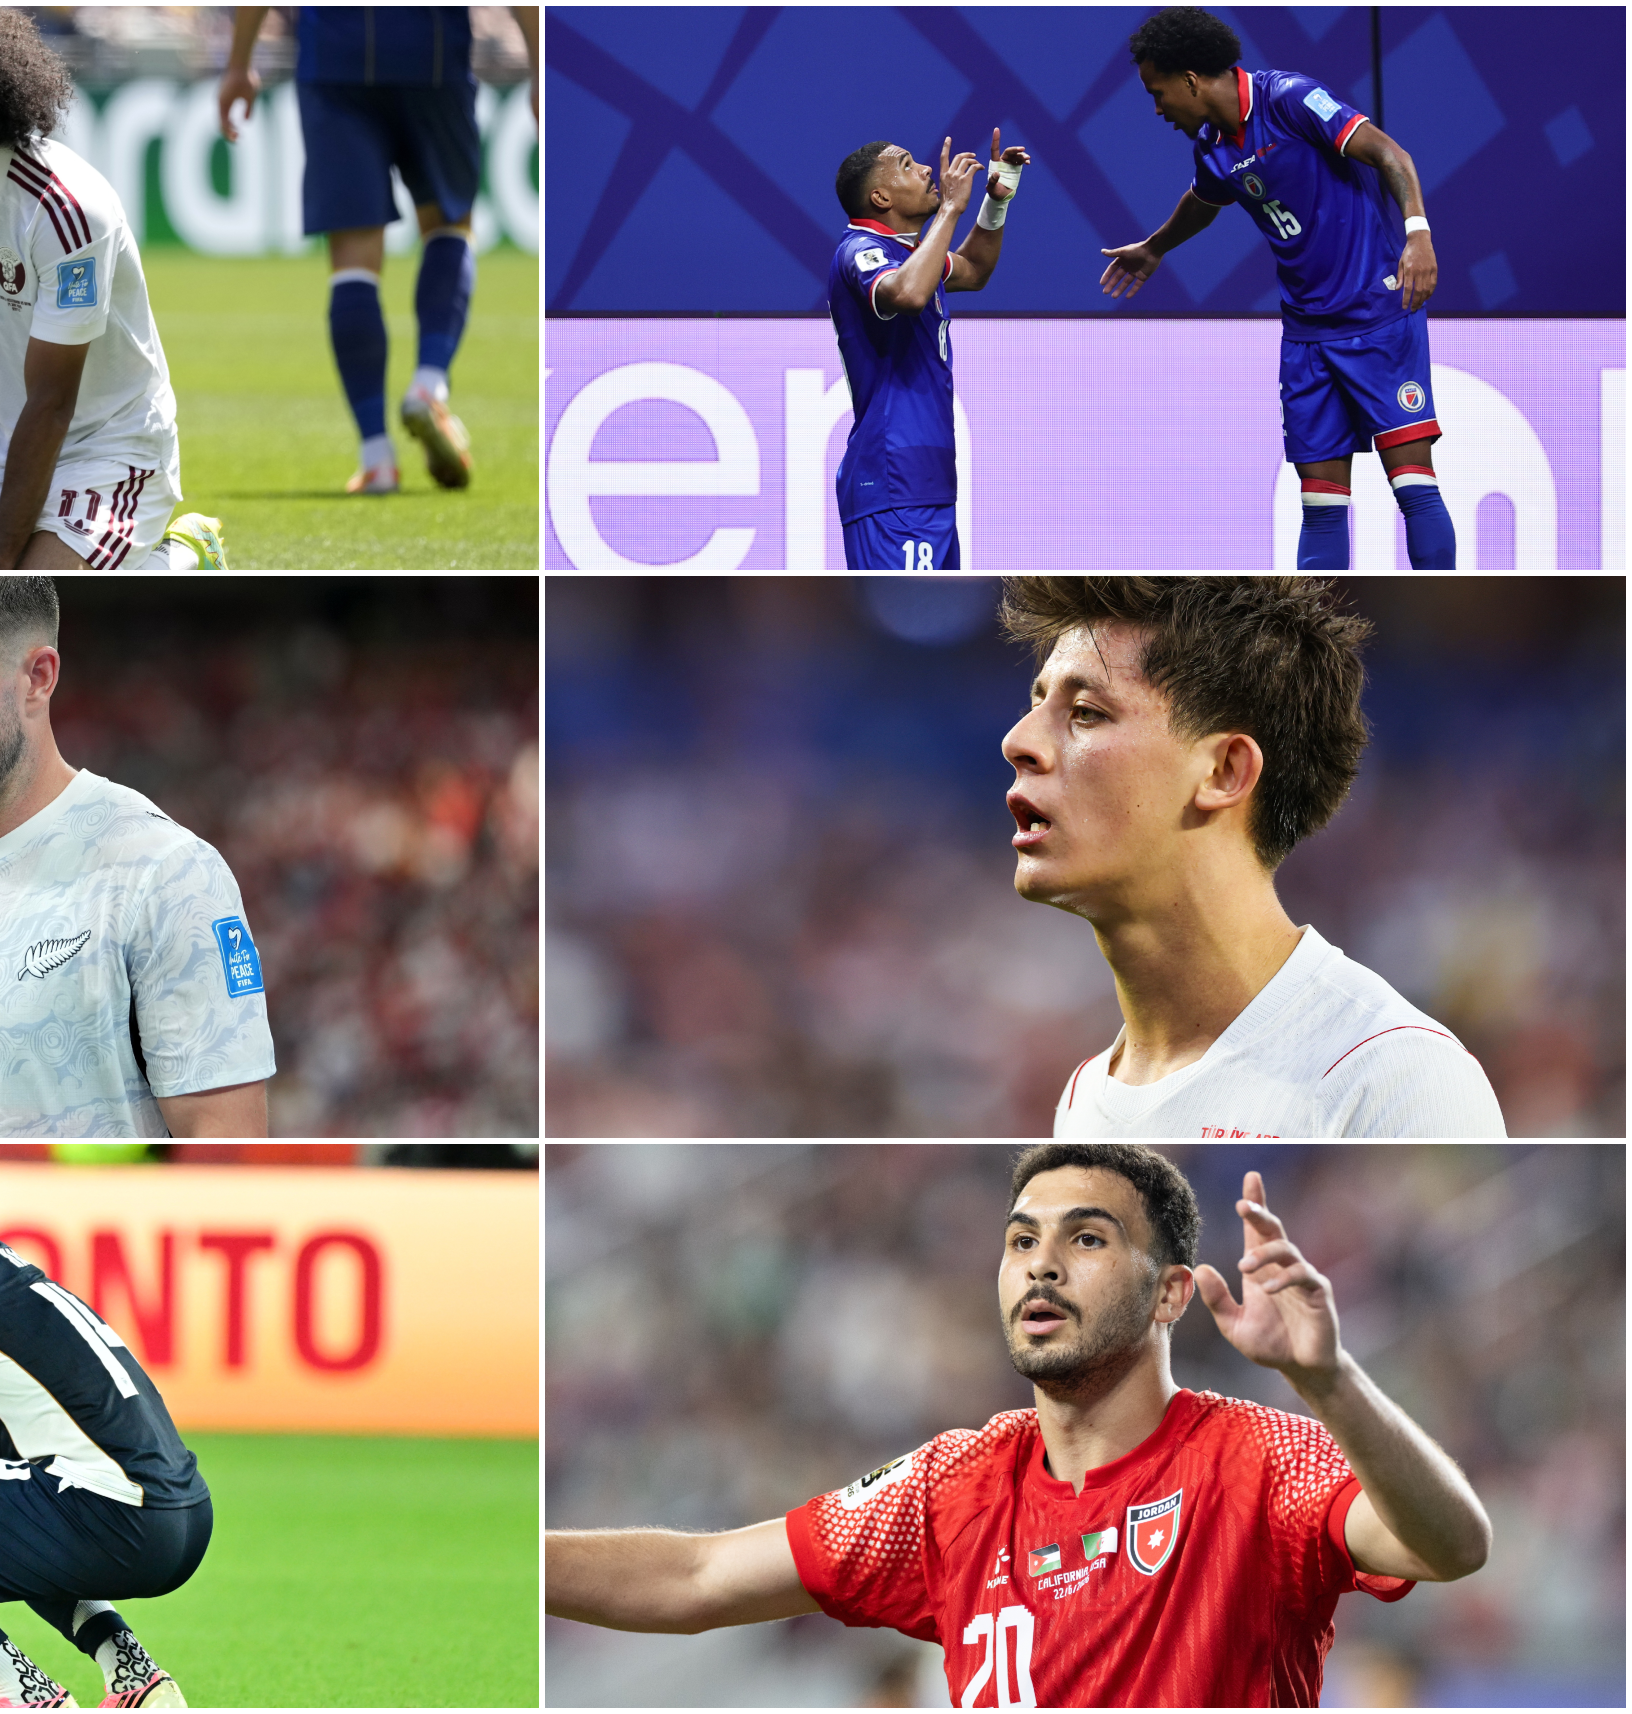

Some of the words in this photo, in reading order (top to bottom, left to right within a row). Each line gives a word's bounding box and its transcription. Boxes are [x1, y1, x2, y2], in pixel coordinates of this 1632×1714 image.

[1262, 199, 1302, 240] 15
[3, 281, 18, 293] QFA
[68, 288, 87, 297] PEACE
[58, 489, 103, 522] 11
[902, 540, 934, 570] 18
[231, 963, 255, 980] PEACE
[237, 978, 253, 987] FIFA
[1137, 1496, 1177, 1520] JORDAN
[1038, 1566, 1089, 1590] CALIFORNIA
[961, 1605, 1037, 1708] 20
